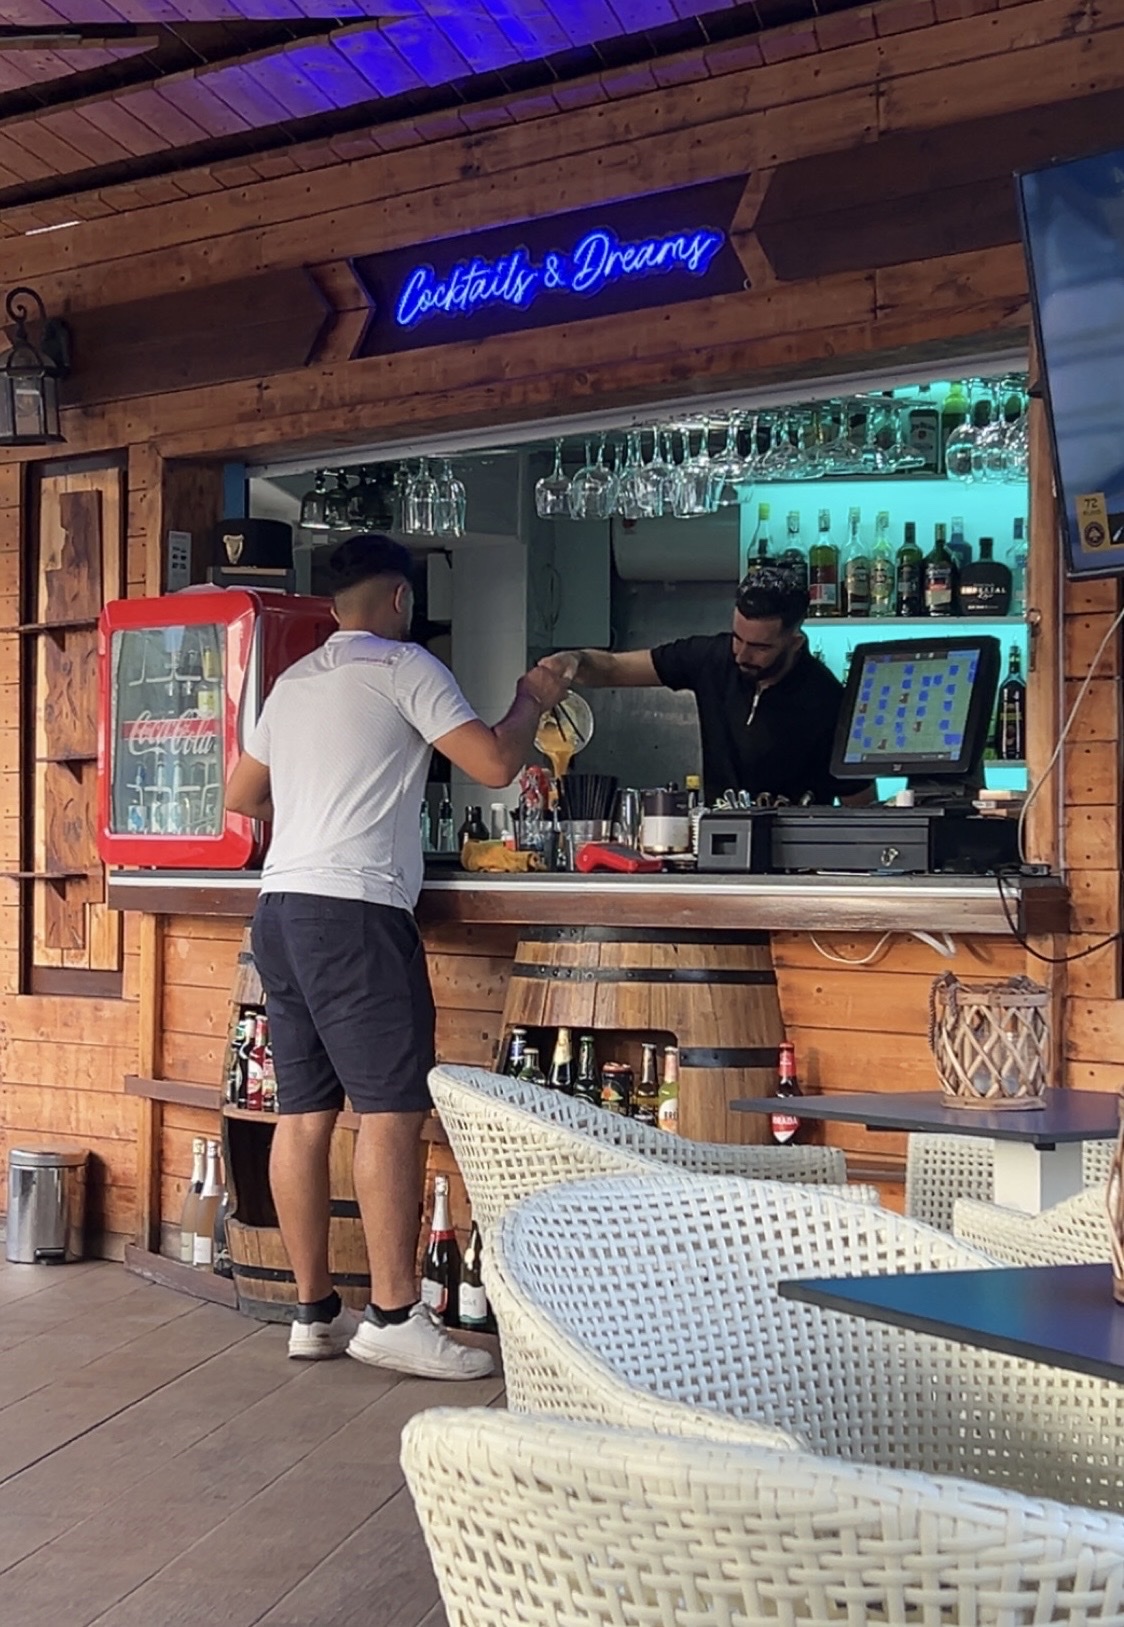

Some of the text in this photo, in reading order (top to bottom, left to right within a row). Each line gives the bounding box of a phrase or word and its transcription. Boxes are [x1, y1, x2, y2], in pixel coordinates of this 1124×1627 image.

[397, 234, 721, 325] Cocktails & Dreams
